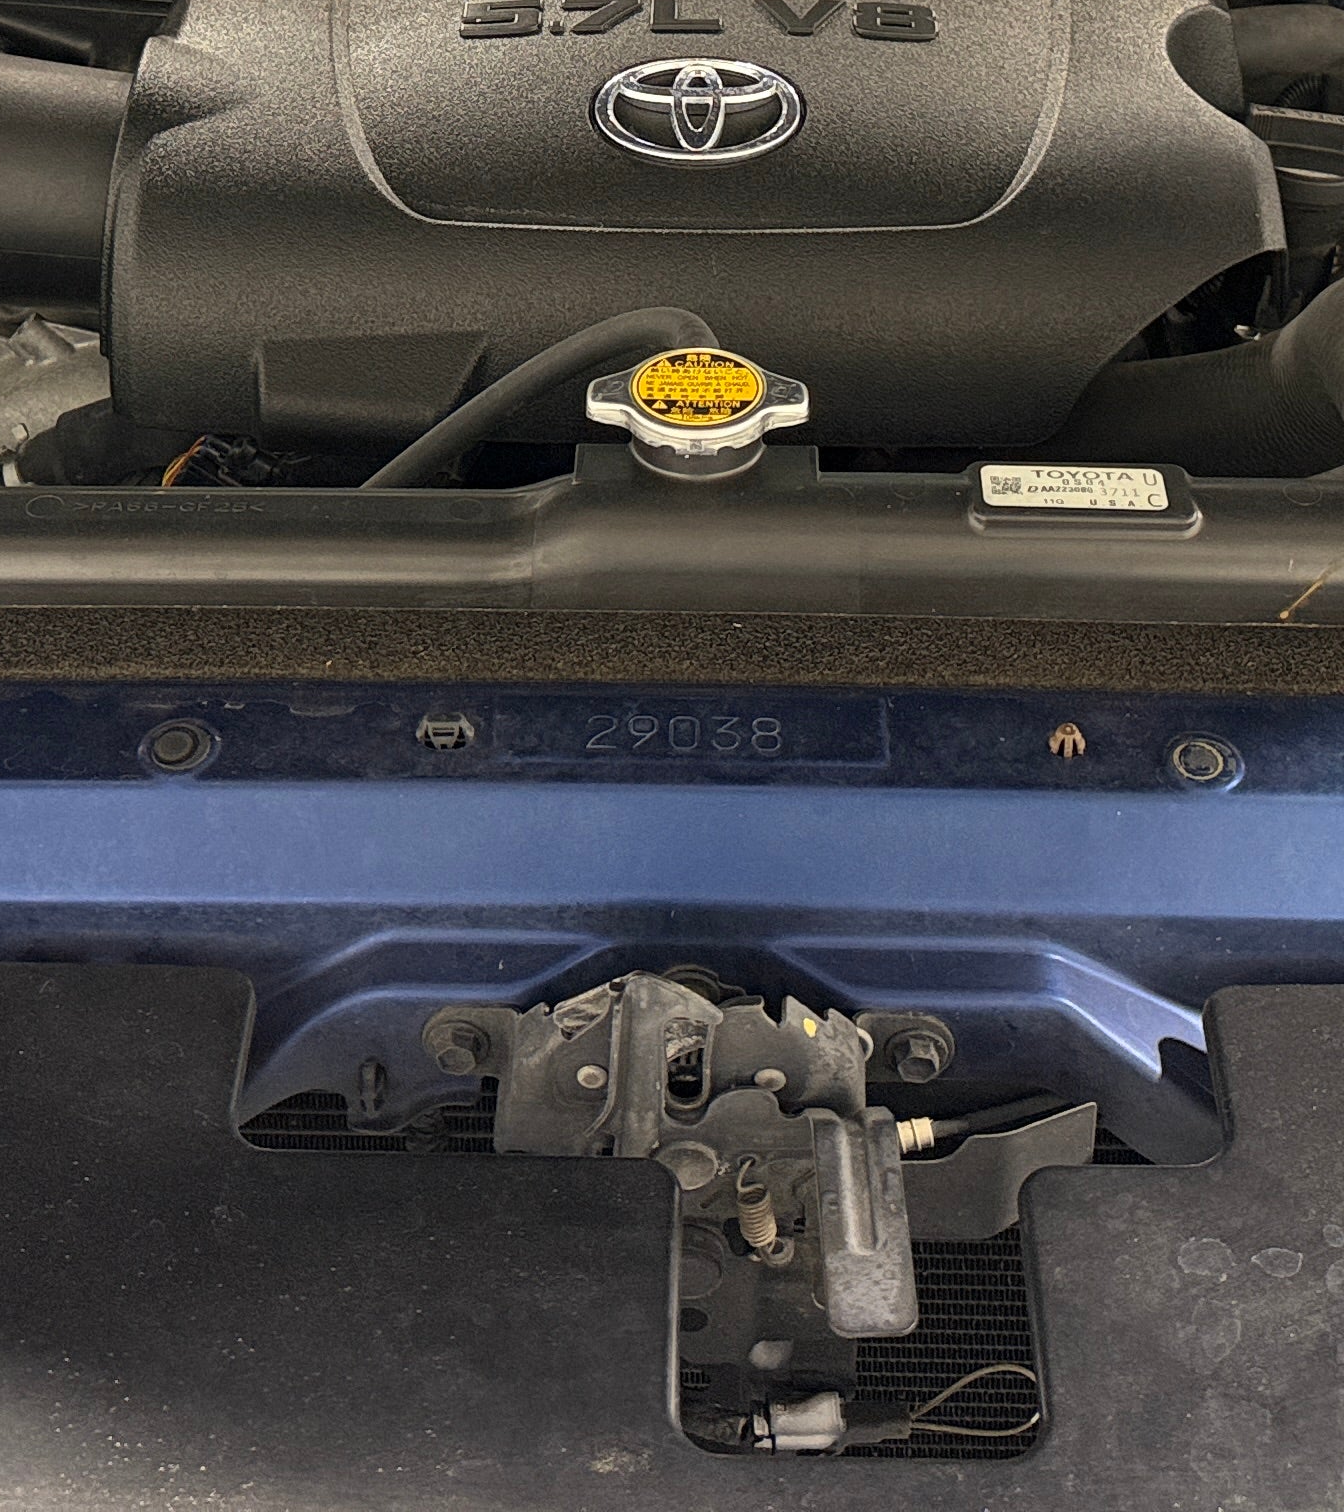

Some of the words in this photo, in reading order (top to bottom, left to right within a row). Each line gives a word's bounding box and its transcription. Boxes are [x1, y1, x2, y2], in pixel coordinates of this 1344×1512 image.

[675, 360, 734, 368] CAUTION
[676, 400, 740, 408] ATTENTION
[1031, 469, 1134, 481] TOYOTA
[586, 715, 782, 752] 29038
